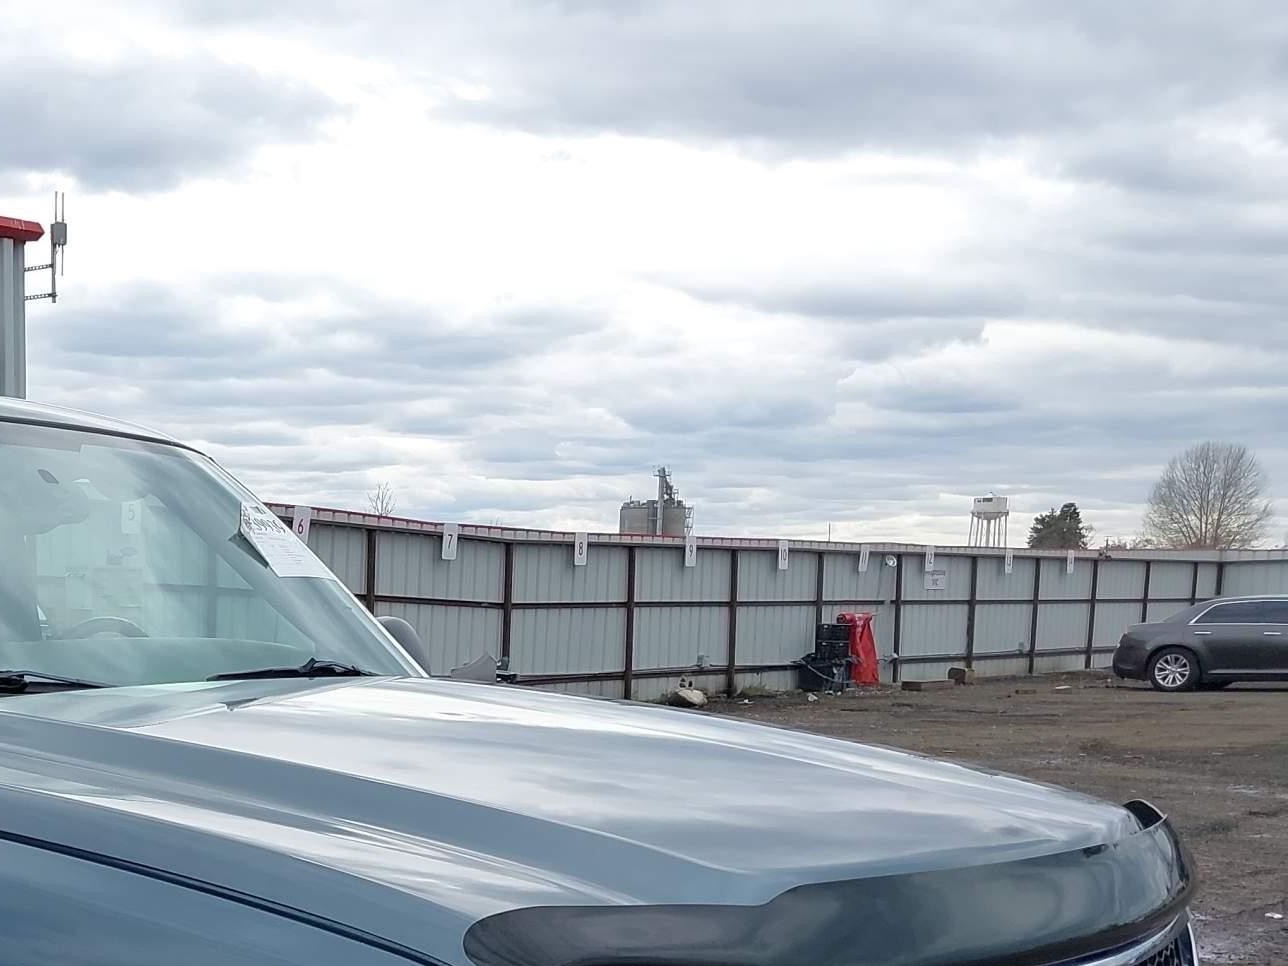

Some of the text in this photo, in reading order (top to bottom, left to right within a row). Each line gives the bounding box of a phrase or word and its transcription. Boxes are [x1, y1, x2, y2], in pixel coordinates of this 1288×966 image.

[128, 503, 136, 521] 5
[297, 518, 304, 535] 6
[447, 534, 453, 550] 7
[578, 541, 584, 556] 8
[688, 544, 694, 558] 9
[780, 549, 787, 561] 10
